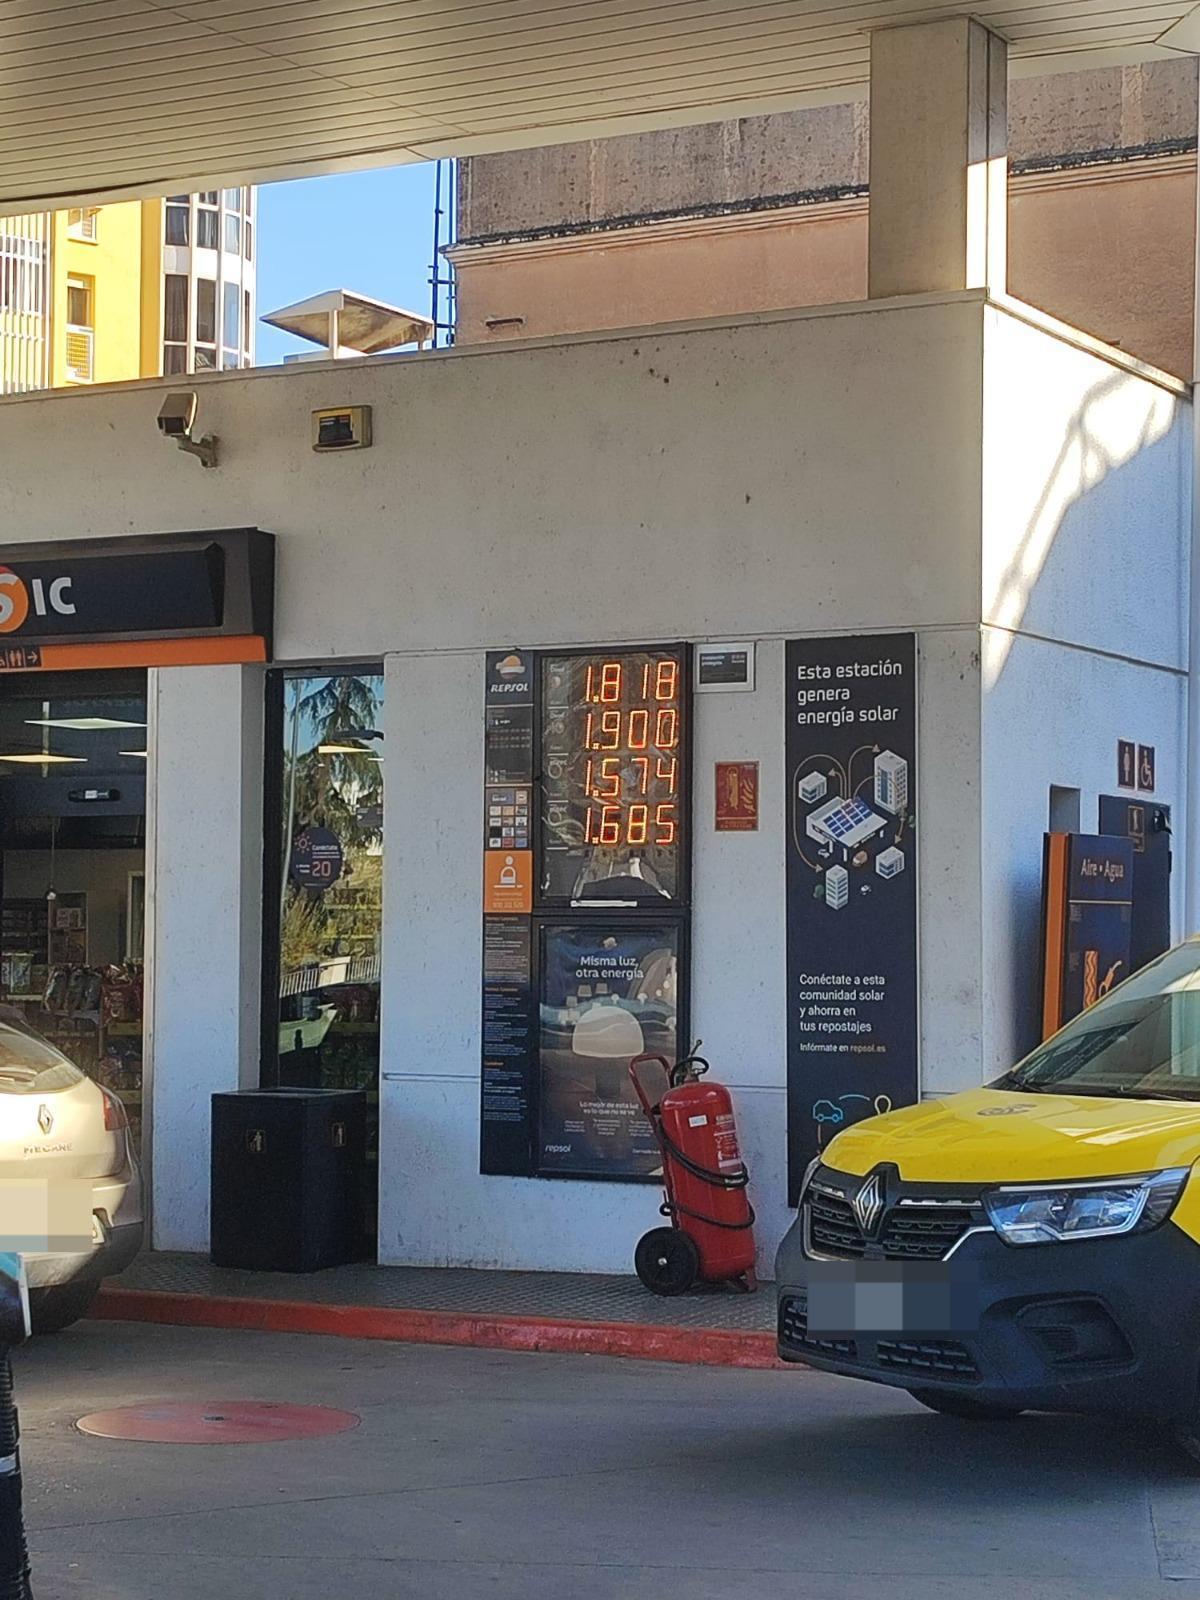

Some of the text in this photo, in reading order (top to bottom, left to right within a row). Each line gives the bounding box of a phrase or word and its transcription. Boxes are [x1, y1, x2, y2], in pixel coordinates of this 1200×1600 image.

[797, 660, 901, 678] Esta estación
[585, 661, 676, 702] 1.818
[491, 683, 528, 696] REPSOL
[797, 688, 850, 706] genera
[797, 705, 898, 725] energía solar
[585, 709, 676, 750] 1.900
[585, 757, 676, 796] 1.574
[584, 804, 675, 844] 1.685
[311, 861, 331, 877] 20
[1080, 858, 1124, 882] Aire Agua
[580, 955, 640, 970] Misma luz,
[575, 968, 645, 981] otra energía
[799, 974, 886, 985] Conéctate a esta
[799, 989, 885, 1001] comunidad solar
[799, 1005, 856, 1018] y ahorra en
[800, 1021, 872, 1034] tus repostajes
[801, 1043, 838, 1051] Infórmate
[839, 1044, 849, 1052] en
[545, 1144, 572, 1153] repsol
